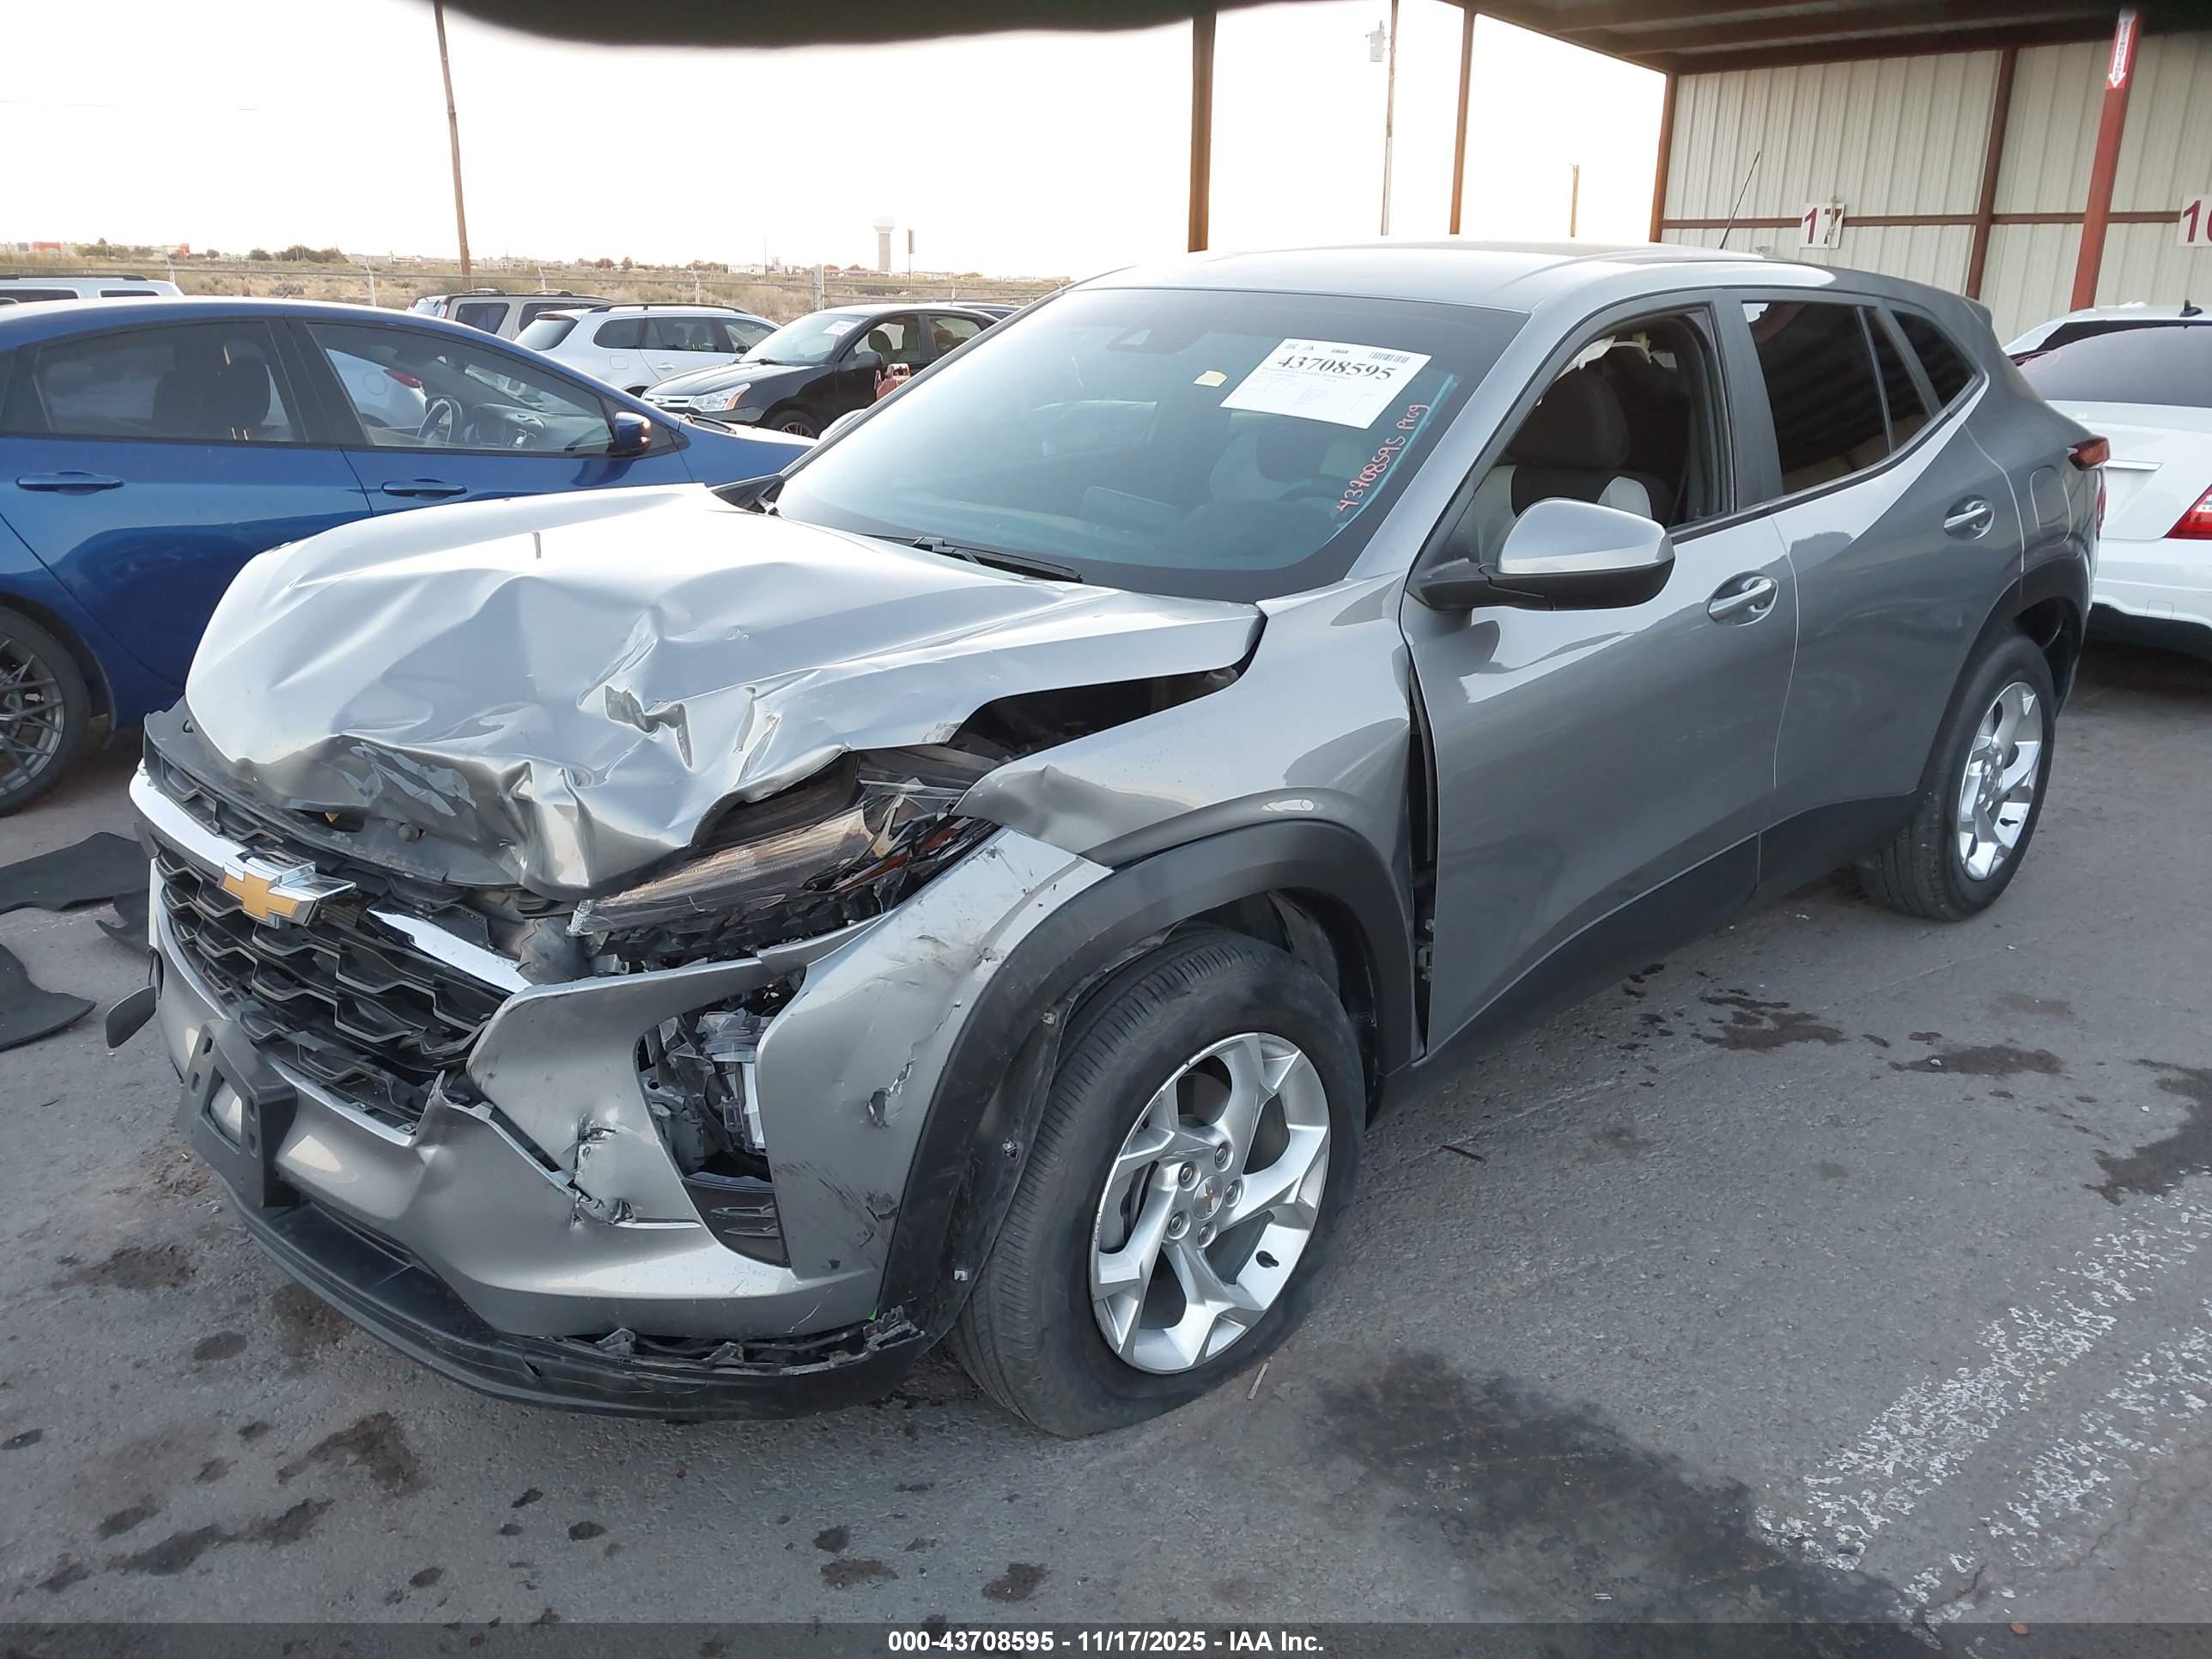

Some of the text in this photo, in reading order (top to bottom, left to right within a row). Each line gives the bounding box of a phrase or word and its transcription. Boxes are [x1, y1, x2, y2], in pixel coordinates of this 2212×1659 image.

[1804, 207, 1843, 245] 17
[1277, 355, 1398, 380] 43708595
[1336, 435, 1407, 512] 43708595
